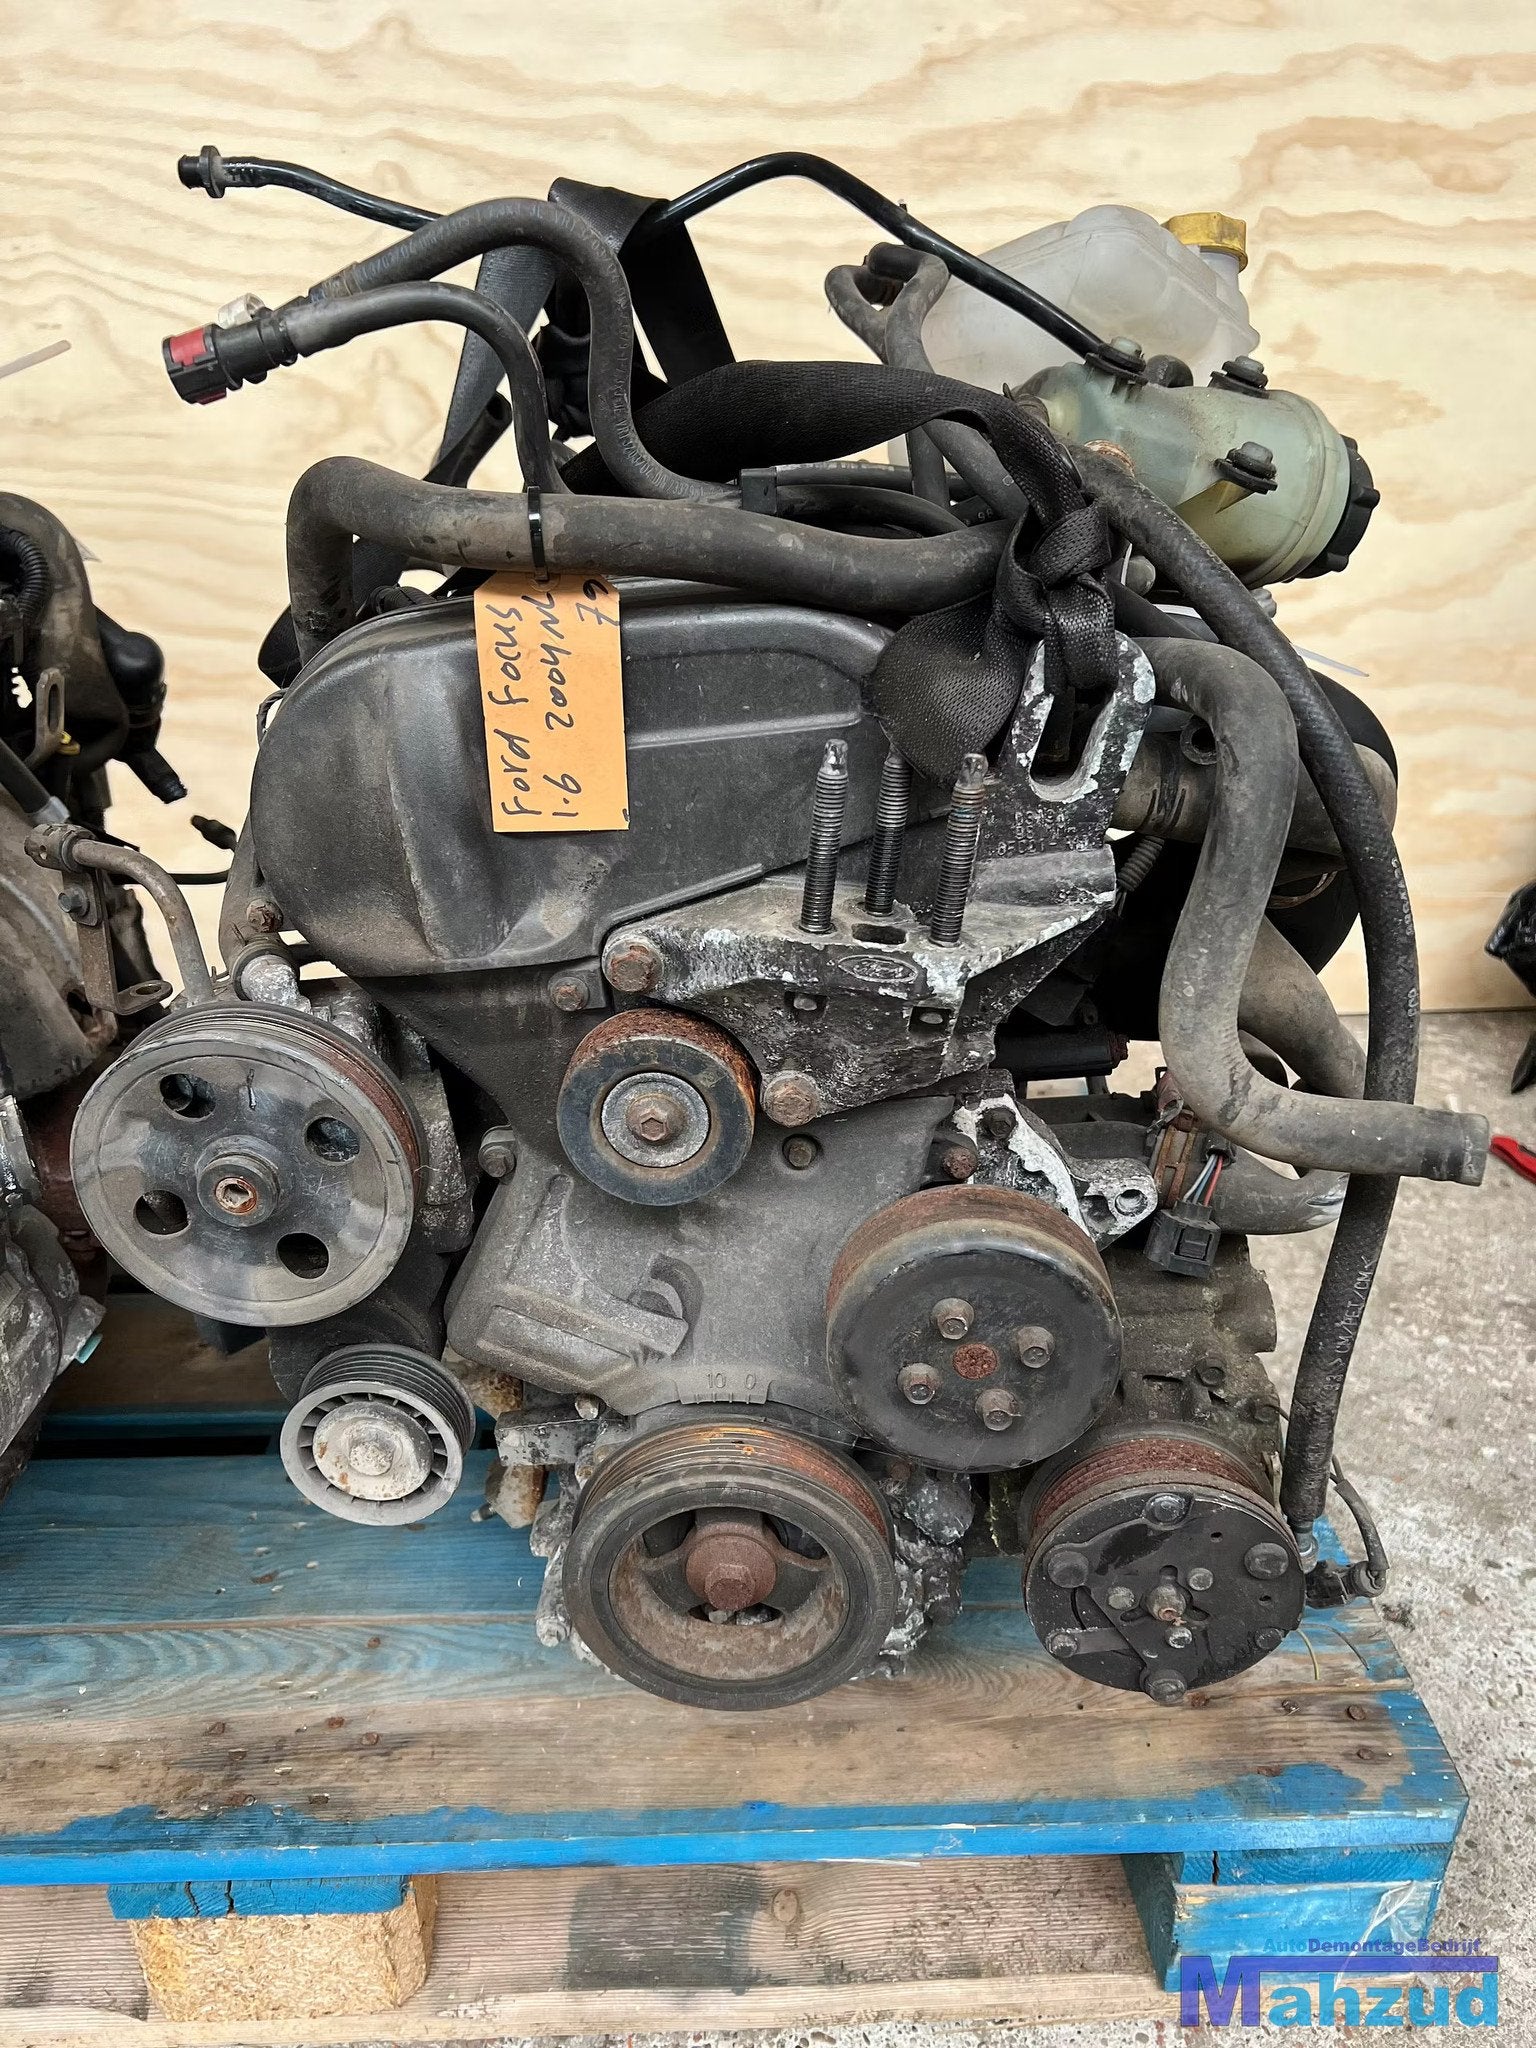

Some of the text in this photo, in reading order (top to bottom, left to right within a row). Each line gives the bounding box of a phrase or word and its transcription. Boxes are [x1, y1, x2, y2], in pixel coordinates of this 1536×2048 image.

[543, 773, 582, 817] 1.6
[706, 1372, 757, 1390] 10 0
